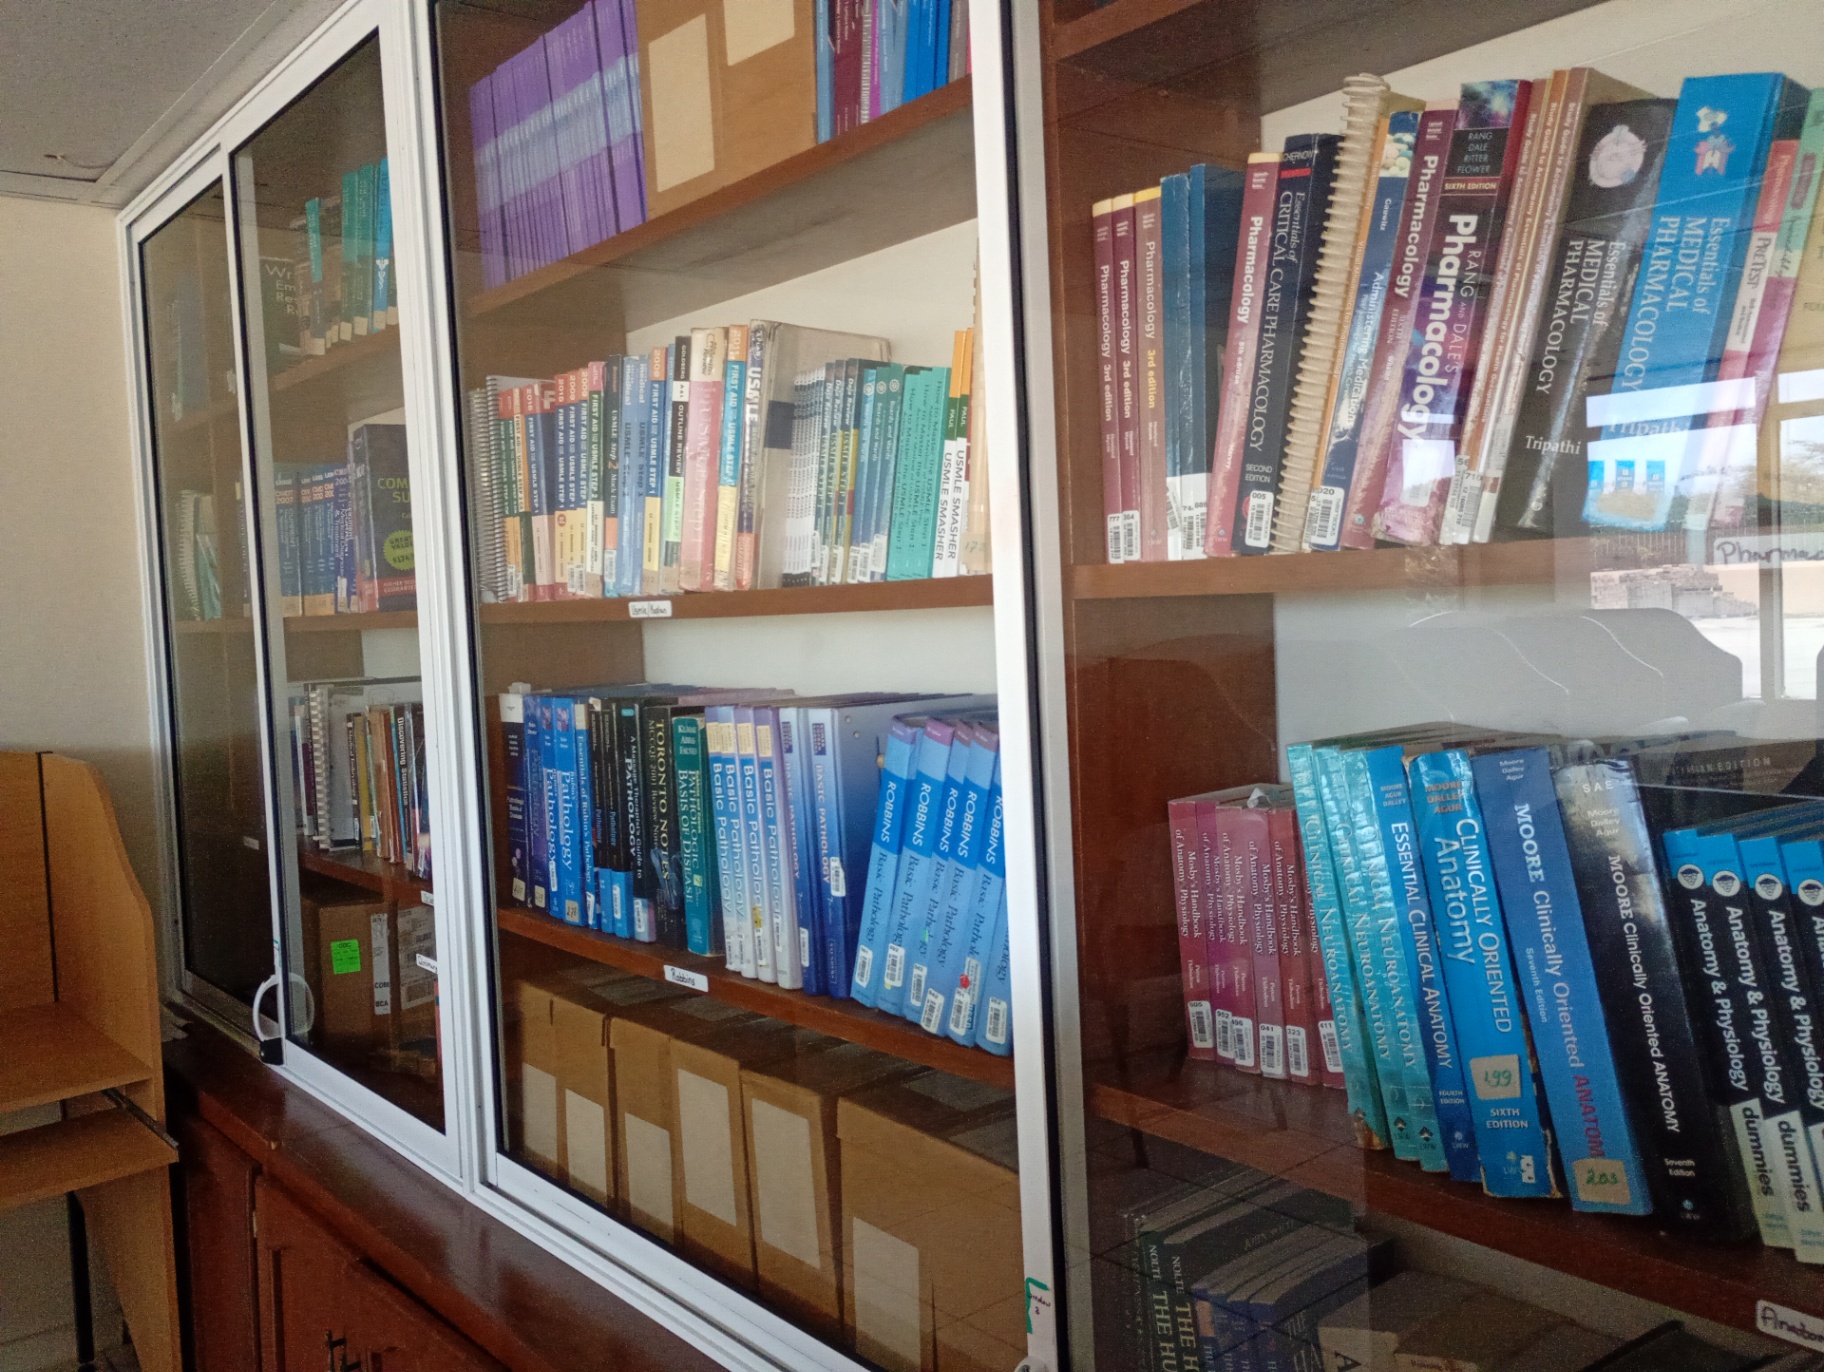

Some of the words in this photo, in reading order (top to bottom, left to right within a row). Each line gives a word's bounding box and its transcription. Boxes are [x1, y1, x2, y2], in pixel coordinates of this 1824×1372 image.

[1464, 154, 1489, 163] RITTER
[1468, 132, 1492, 141] RANG
[1468, 143, 1488, 152] DALE
[1444, 183, 1466, 191] SIXTH
[1468, 182, 1497, 191] EDITION
[1457, 165, 1490, 174] FLOWER
[1272, 191, 1293, 263] CRITICAL
[1291, 192, 1306, 248] Essentials
[1396, 155, 1438, 298] Pharmacology
[1236, 216, 1264, 325] Pharmacology
[1461, 250, 1482, 298] RANG
[1597, 240, 1627, 306] Essentials
[1666, 216, 1708, 312] MEDICAL
[1699, 216, 1731, 294] Essentials
[1144, 241, 1156, 340] Pharmacology
[1267, 267, 1284, 312] CARE
[1570, 240, 1605, 324] MEDICAL
[1622, 216, 1681, 393] PHARMACOLOGY
[1100, 265, 1111, 359] Pharmacology
[1120, 260, 1131, 354] Pharmacology
[1358, 271, 1384, 359] Administering
[1398, 214, 1479, 440] Pharmacology
[1536, 240, 1585, 396] PHARMACOLOGY
[1592, 311, 1608, 327] of
[1692, 299, 1709, 315] of
[1122, 360, 1131, 379] 3rd
[1147, 349, 1156, 368] 3rd
[1446, 323, 1467, 373] DALE'S
[730, 365, 739, 392] FIRST
[748, 367, 761, 422] USMLE
[1103, 364, 1111, 382] 3rd
[1147, 370, 1156, 410] edition
[1250, 315, 1279, 452] PHARMACOLOGY
[591, 394, 599, 418] FIRST
[1104, 386, 1112, 422] edition
[1123, 381, 1132, 419] edition
[590, 444, 599, 469] USMLE
[727, 422, 736, 451] USMLE
[1525, 435, 1581, 455] Tripathi
[941, 452, 953, 495] USMLE
[953, 449, 965, 493] USMLE
[1245, 464, 1273, 474] SECOND
[1245, 474, 1270, 484] EDITION
[935, 499, 948, 561] SMASHER
[947, 497, 961, 559] SMASHER
[397, 717, 408, 766] Discovering
[656, 719, 668, 813] TORONTO
[678, 770, 689, 813] BASIS
[713, 763, 724, 811] Basic
[725, 764, 737, 813] Basic
[743, 765, 756, 814] Basic
[763, 768, 774, 818] Basic
[815, 764, 825, 803] BASIC
[1502, 766, 1524, 774] Dalley
[561, 772, 572, 870] Pathology
[625, 758, 636, 857] PATHOLOGY
[880, 781, 896, 842] ROBBINS
[913, 783, 931, 847] ROBBINS
[939, 787, 958, 852] ROBBINS
[958, 791, 977, 858] ROBBINS
[986, 795, 1004, 864] ROBBINS
[1587, 808, 1619, 819] Moore
[1590, 818, 1620, 828] Dalley
[1596, 827, 1619, 837] Agur
[717, 816, 732, 913] Pathology
[730, 818, 744, 917] Pathology
[819, 806, 831, 885] PATHOLOGY
[1176, 840, 1187, 884] Anatomy
[1188, 851, 1199, 887] Mosby's
[1223, 844, 1232, 887] Anatomy
[682, 839, 694, 903] DISEASE
[1234, 855, 1243, 893] Mosby's
[1249, 851, 1259, 897] Anatomy
[1262, 863, 1271, 901] Mosby's
[1287, 864, 1295, 902] Mosby's
[1180, 889, 1189, 938] Physiology
[1191, 889, 1202, 938] Handbook
[1227, 894, 1235, 944] Physiology
[1237, 896, 1247, 945] Handbook
[1275, 852, 1284, 897] Anatomy
[1280, 904, 1290, 956] Physiology
[1435, 837, 1476, 965] Anatomy
[1253, 904, 1263, 956] Physiology
[1265, 904, 1275, 956] Handbook
[1290, 905, 1301, 957] Handbook
[1391, 822, 1418, 904] ESSENTIAL
[1408, 908, 1436, 984] CLINICAL
[1423, 987, 1453, 1069] ANATOMY
[1456, 818, 1493, 927] CLINICALLY
[1478, 932, 1512, 1034] ORIENTED
[1691, 899, 1721, 978] Anatomy
[1726, 906, 1757, 988] Anatomy
[1526, 947, 1543, 986] Seventh
[1768, 909, 1800, 993] Anatomy
[1319, 908, 1352, 1051] NEUROANATOMY
[1353, 911, 1390, 1061] NEUROANATOMY
[1378, 916, 1416, 1069] NEUROANATOMY
[1514, 803, 1545, 883] MOORE
[1533, 890, 1563, 979] Clinically
[1552, 982, 1585, 1068] Oriented
[1574, 1074, 1606, 1158] ANATOM
[1608, 855, 1633, 919] MOORE
[1623, 922, 1648, 990] Clinically
[1638, 993, 1664, 1057] Oriented
[1653, 1060, 1680, 1133] ANATOMY
[1711, 980, 1727, 995] &
[1747, 990, 1764, 1005] &
[1790, 997, 1806, 1011] &
[1534, 988, 1548, 1023] Edition
[1714, 998, 1749, 1092] Physiology
[1751, 1007, 1786, 1105] Physiology
[1794, 1013, 1824, 1110] Physiology
[1486, 1120, 1528, 1129] EDITION
[1490, 1107, 1520, 1117] SIXTH
[1664, 1158, 1695, 1168] Seventh
[1669, 1168, 1695, 1178] Edition
[1742, 1107, 1774, 1197] dummies
[1778, 1120, 1811, 1212] dummies
[1153, 1290, 1172, 1336] THE
[1176, 1302, 1197, 1348] THE
